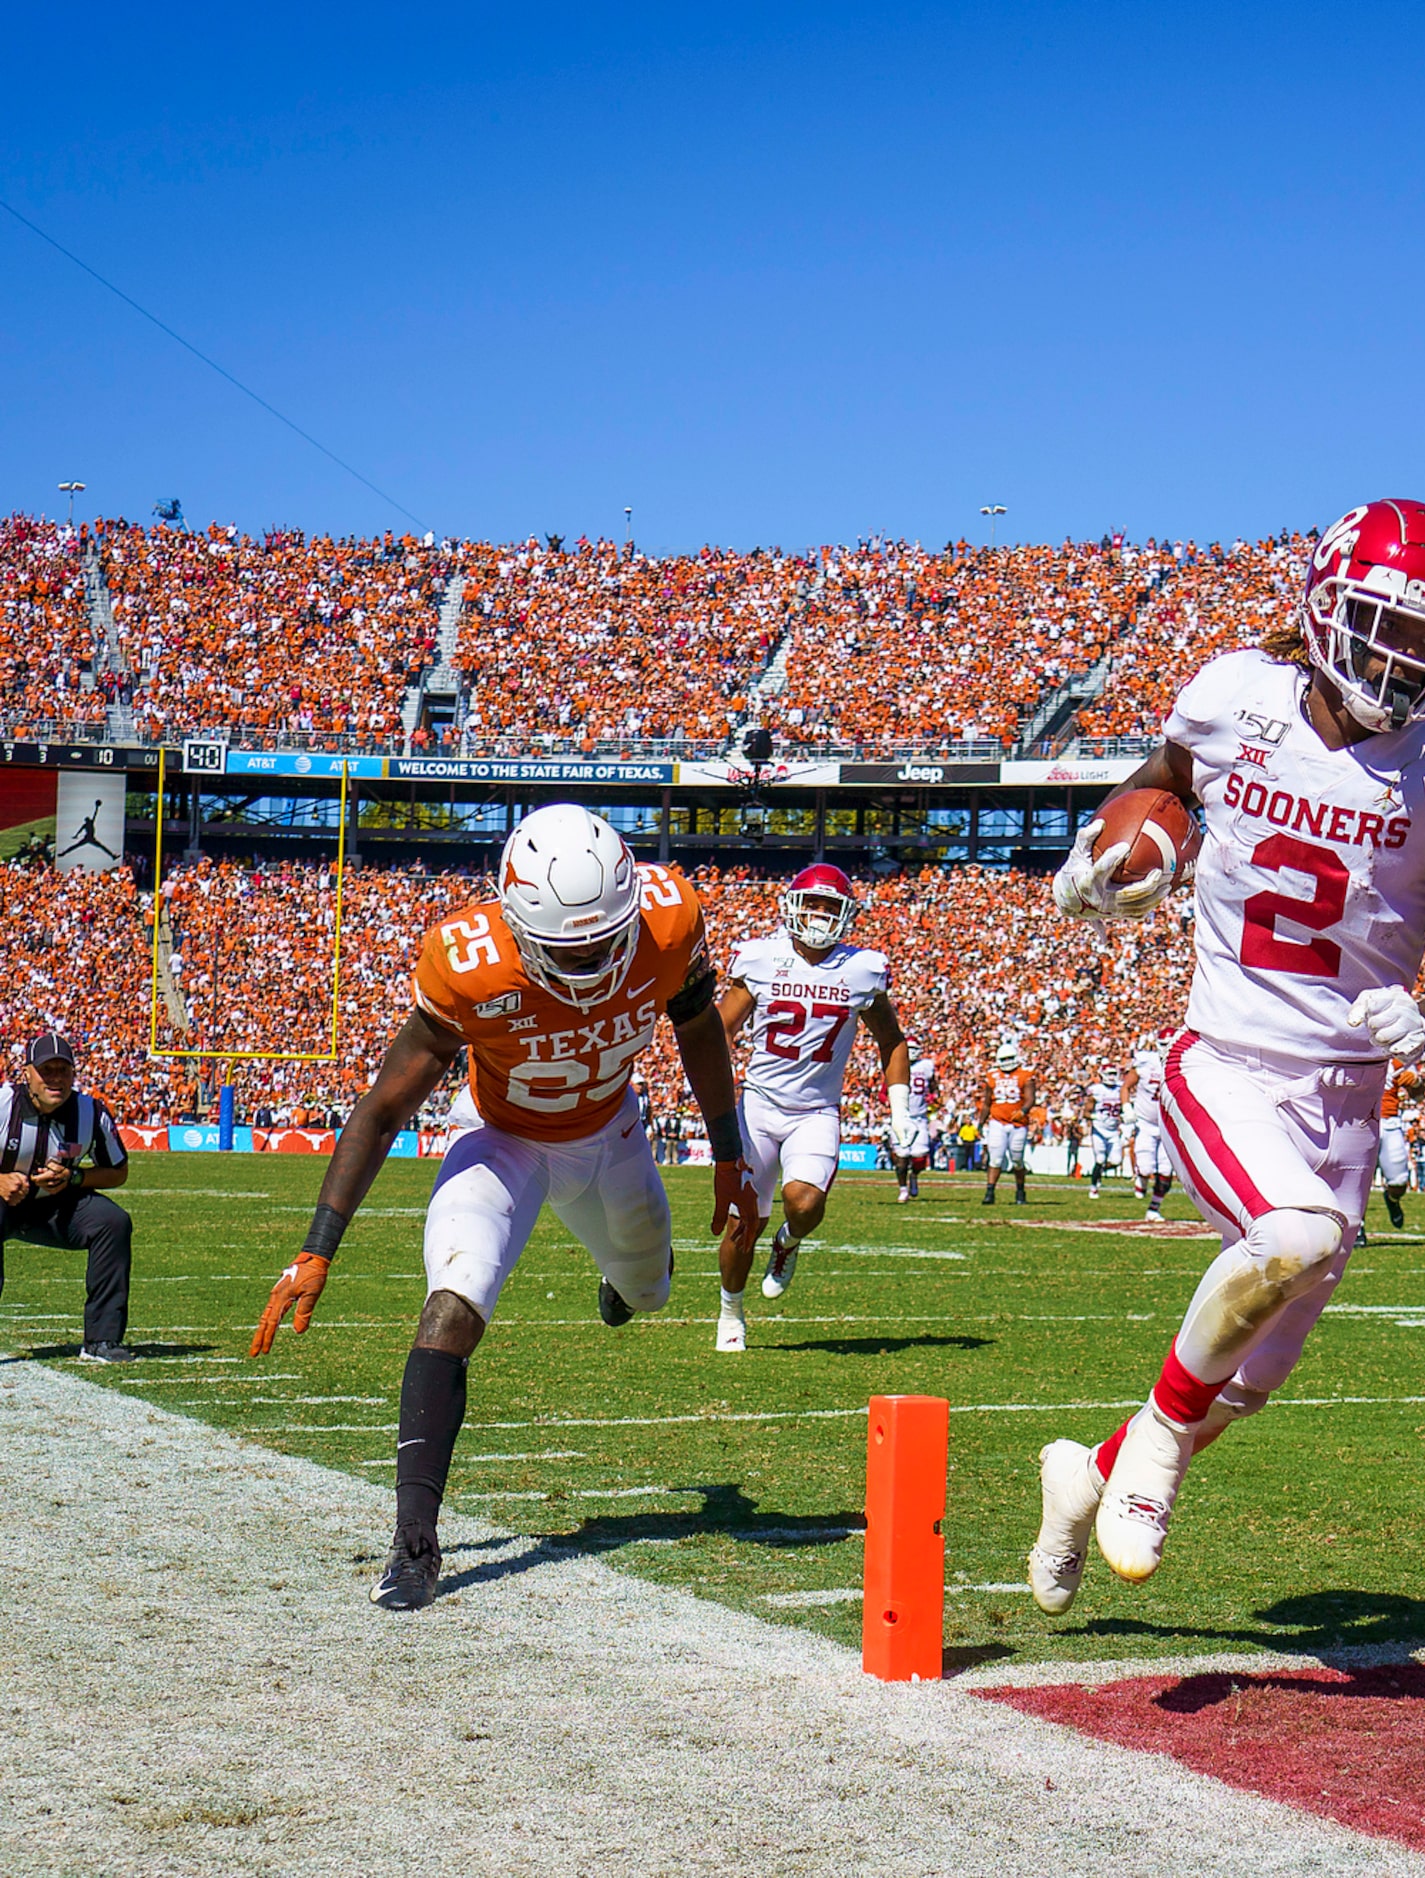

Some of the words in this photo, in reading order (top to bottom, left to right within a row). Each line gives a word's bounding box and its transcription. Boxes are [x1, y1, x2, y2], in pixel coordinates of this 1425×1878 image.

[189, 746, 219, 768] 40
[247, 757, 277, 769] AT&T
[1235, 742, 1272, 770] XII
[398, 762, 468, 776] WELCOME
[470, 764, 489, 777] TO
[491, 765, 519, 778] THE
[521, 765, 560, 778] STATE
[562, 766, 593, 779] FAIR
[595, 766, 616, 779] OF
[617, 767, 664, 780] TEXAS.
[897, 764, 944, 783] Jeep
[1080, 770, 1109, 780] LIGHT
[1223, 772, 1412, 849] SOONERS
[1240, 832, 1350, 978] 2
[440, 912, 501, 974] 25
[771, 982, 850, 1002] SOONERS
[507, 1014, 539, 1033] XII
[519, 999, 657, 1061] TEXAS
[765, 1000, 850, 1063] 27
[505, 1024, 656, 1114] 25
[7, 1137, 20, 1151] S
[205, 1133, 238, 1145] ATT
[839, 1150, 866, 1162] AT&T
